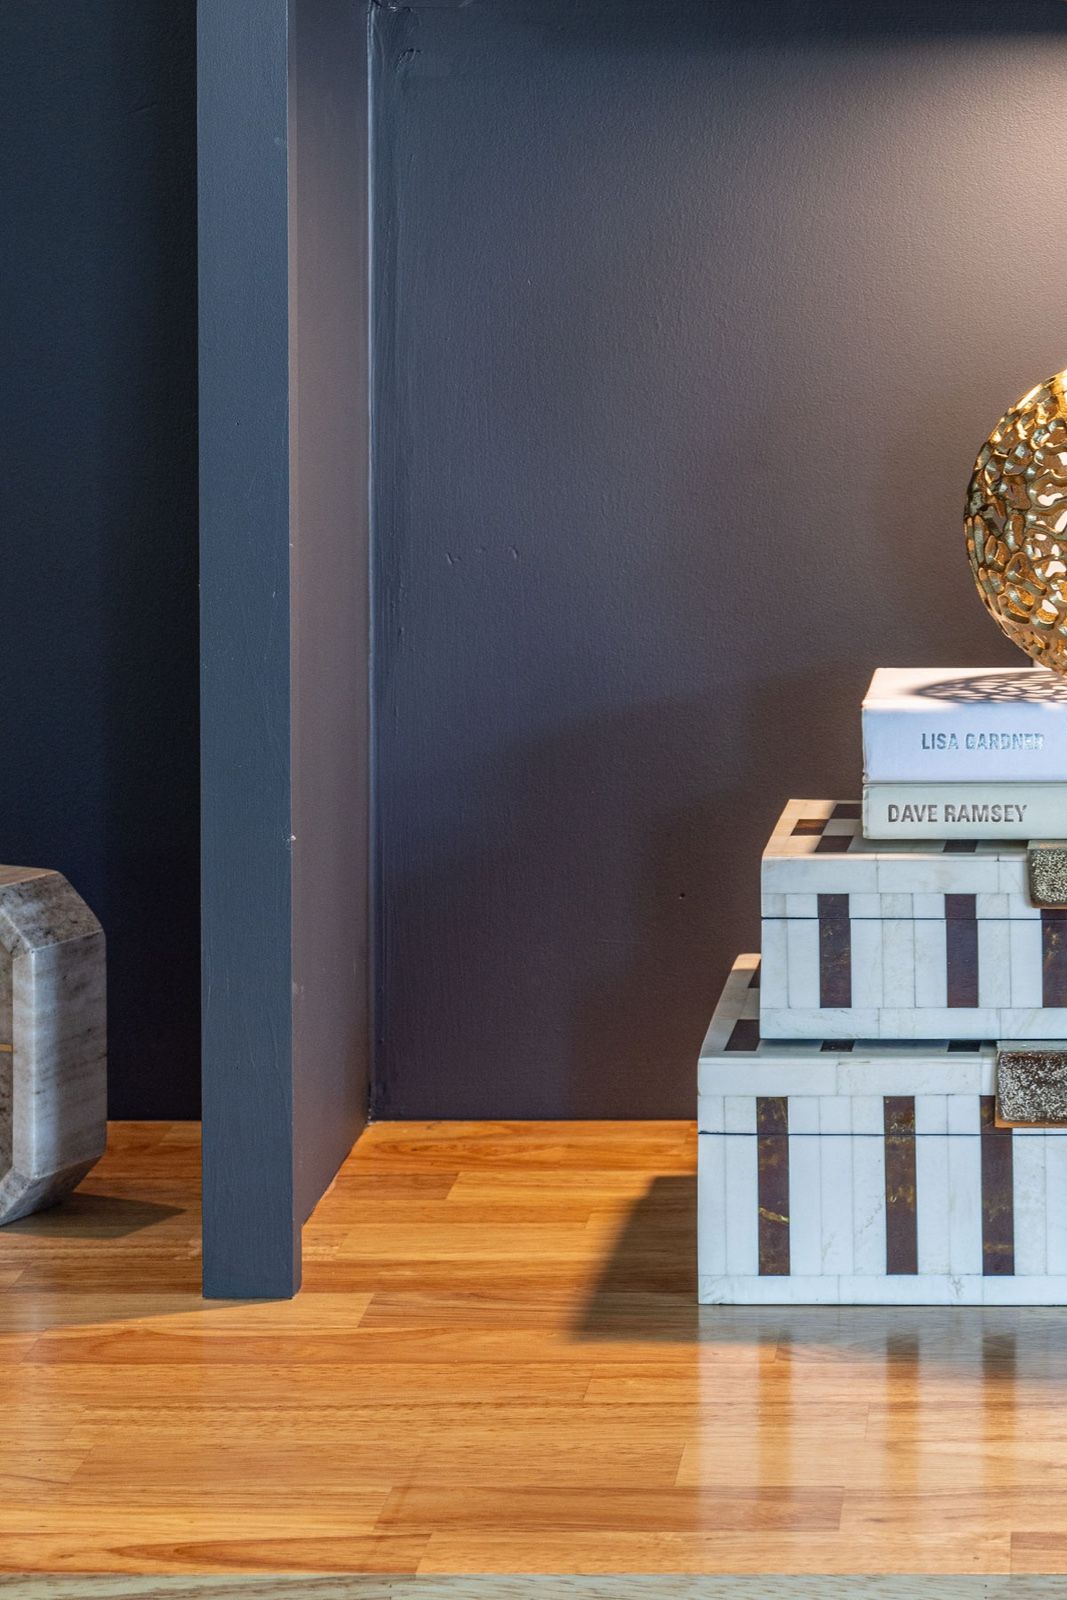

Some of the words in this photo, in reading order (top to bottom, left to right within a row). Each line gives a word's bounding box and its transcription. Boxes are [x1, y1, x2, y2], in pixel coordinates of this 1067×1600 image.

[921, 733, 959, 750] LISA
[965, 733, 1045, 750] GARDNER
[887, 804, 938, 822] DAVE
[944, 804, 1028, 822] RAMSEY
